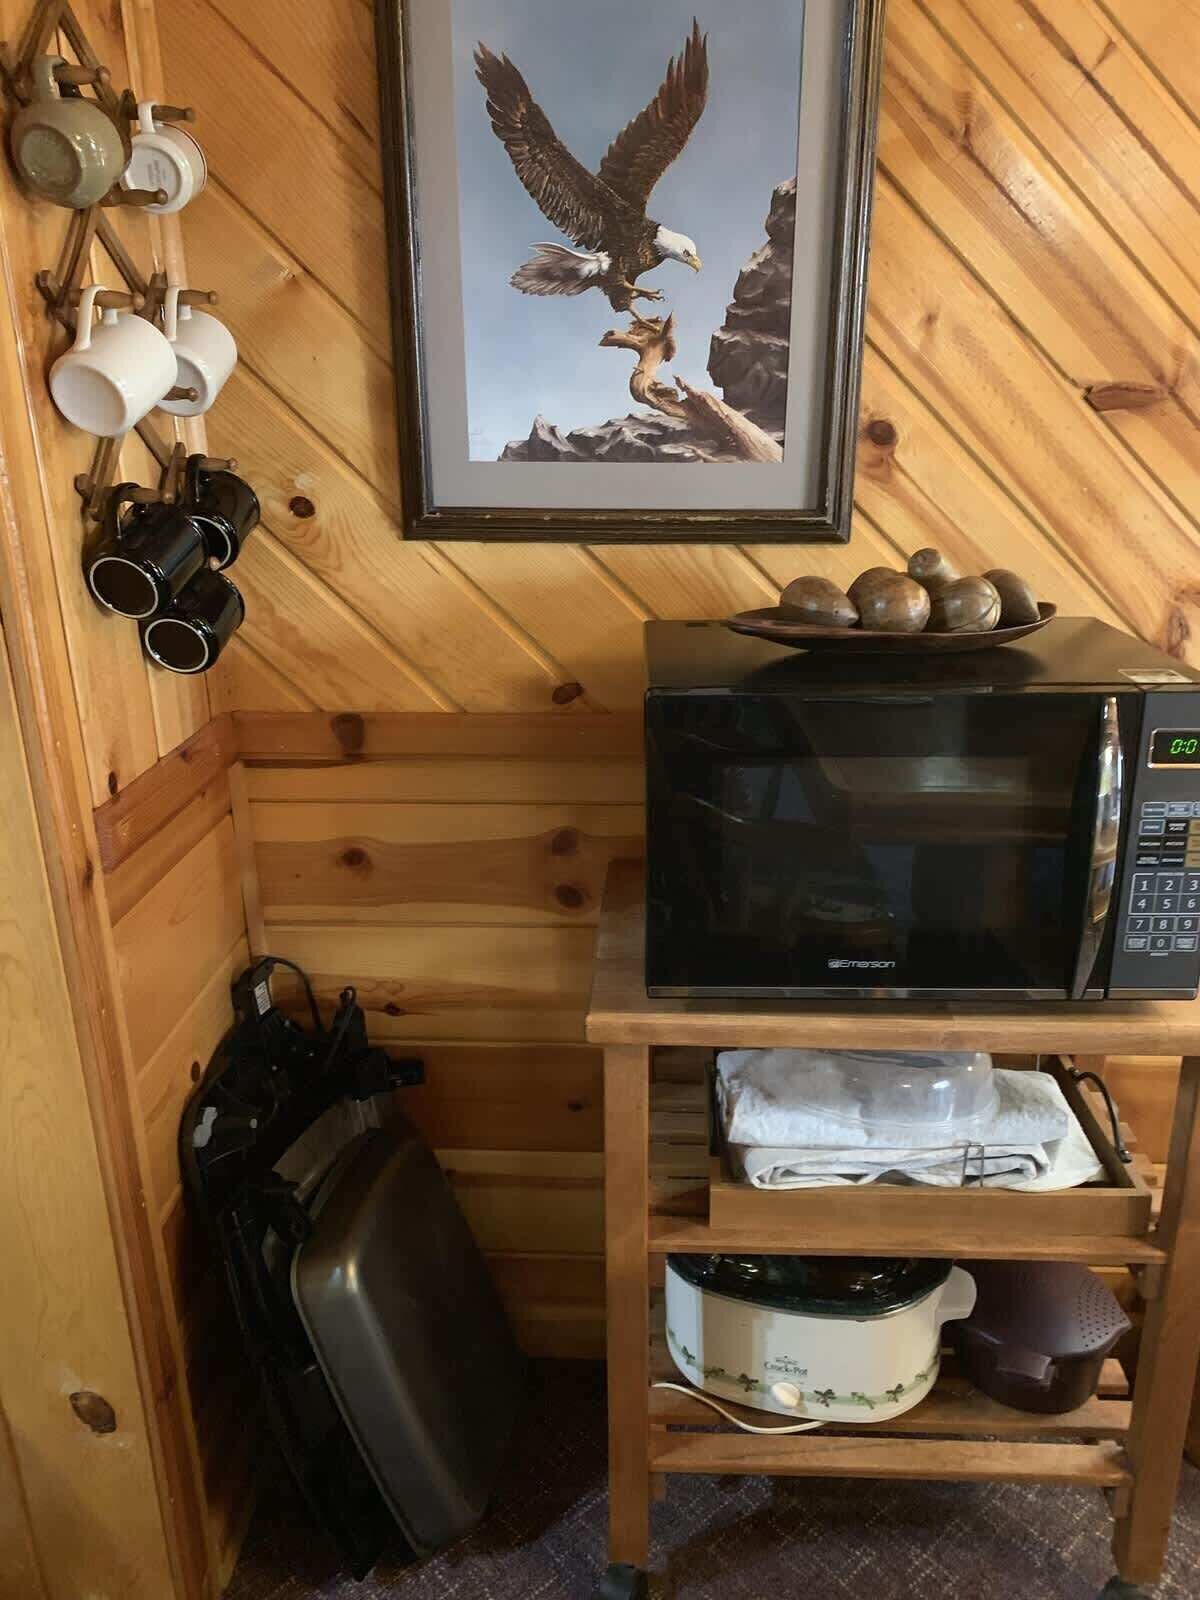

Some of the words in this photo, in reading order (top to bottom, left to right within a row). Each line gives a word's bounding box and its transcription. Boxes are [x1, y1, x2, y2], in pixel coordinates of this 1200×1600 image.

[1140, 880, 1148, 891] 1
[1164, 880, 1173, 891] 2
[1189, 880, 1198, 891] 3
[1137, 899, 1146, 909] 4
[1162, 899, 1172, 909] 5
[1187, 899, 1196, 909] 6
[1135, 920, 1144, 929] 7
[1159, 920, 1168, 929] 8
[1183, 920, 1192, 929] 9
[1156, 938, 1165, 948] 0
[840, 959, 896, 968] Emerson
